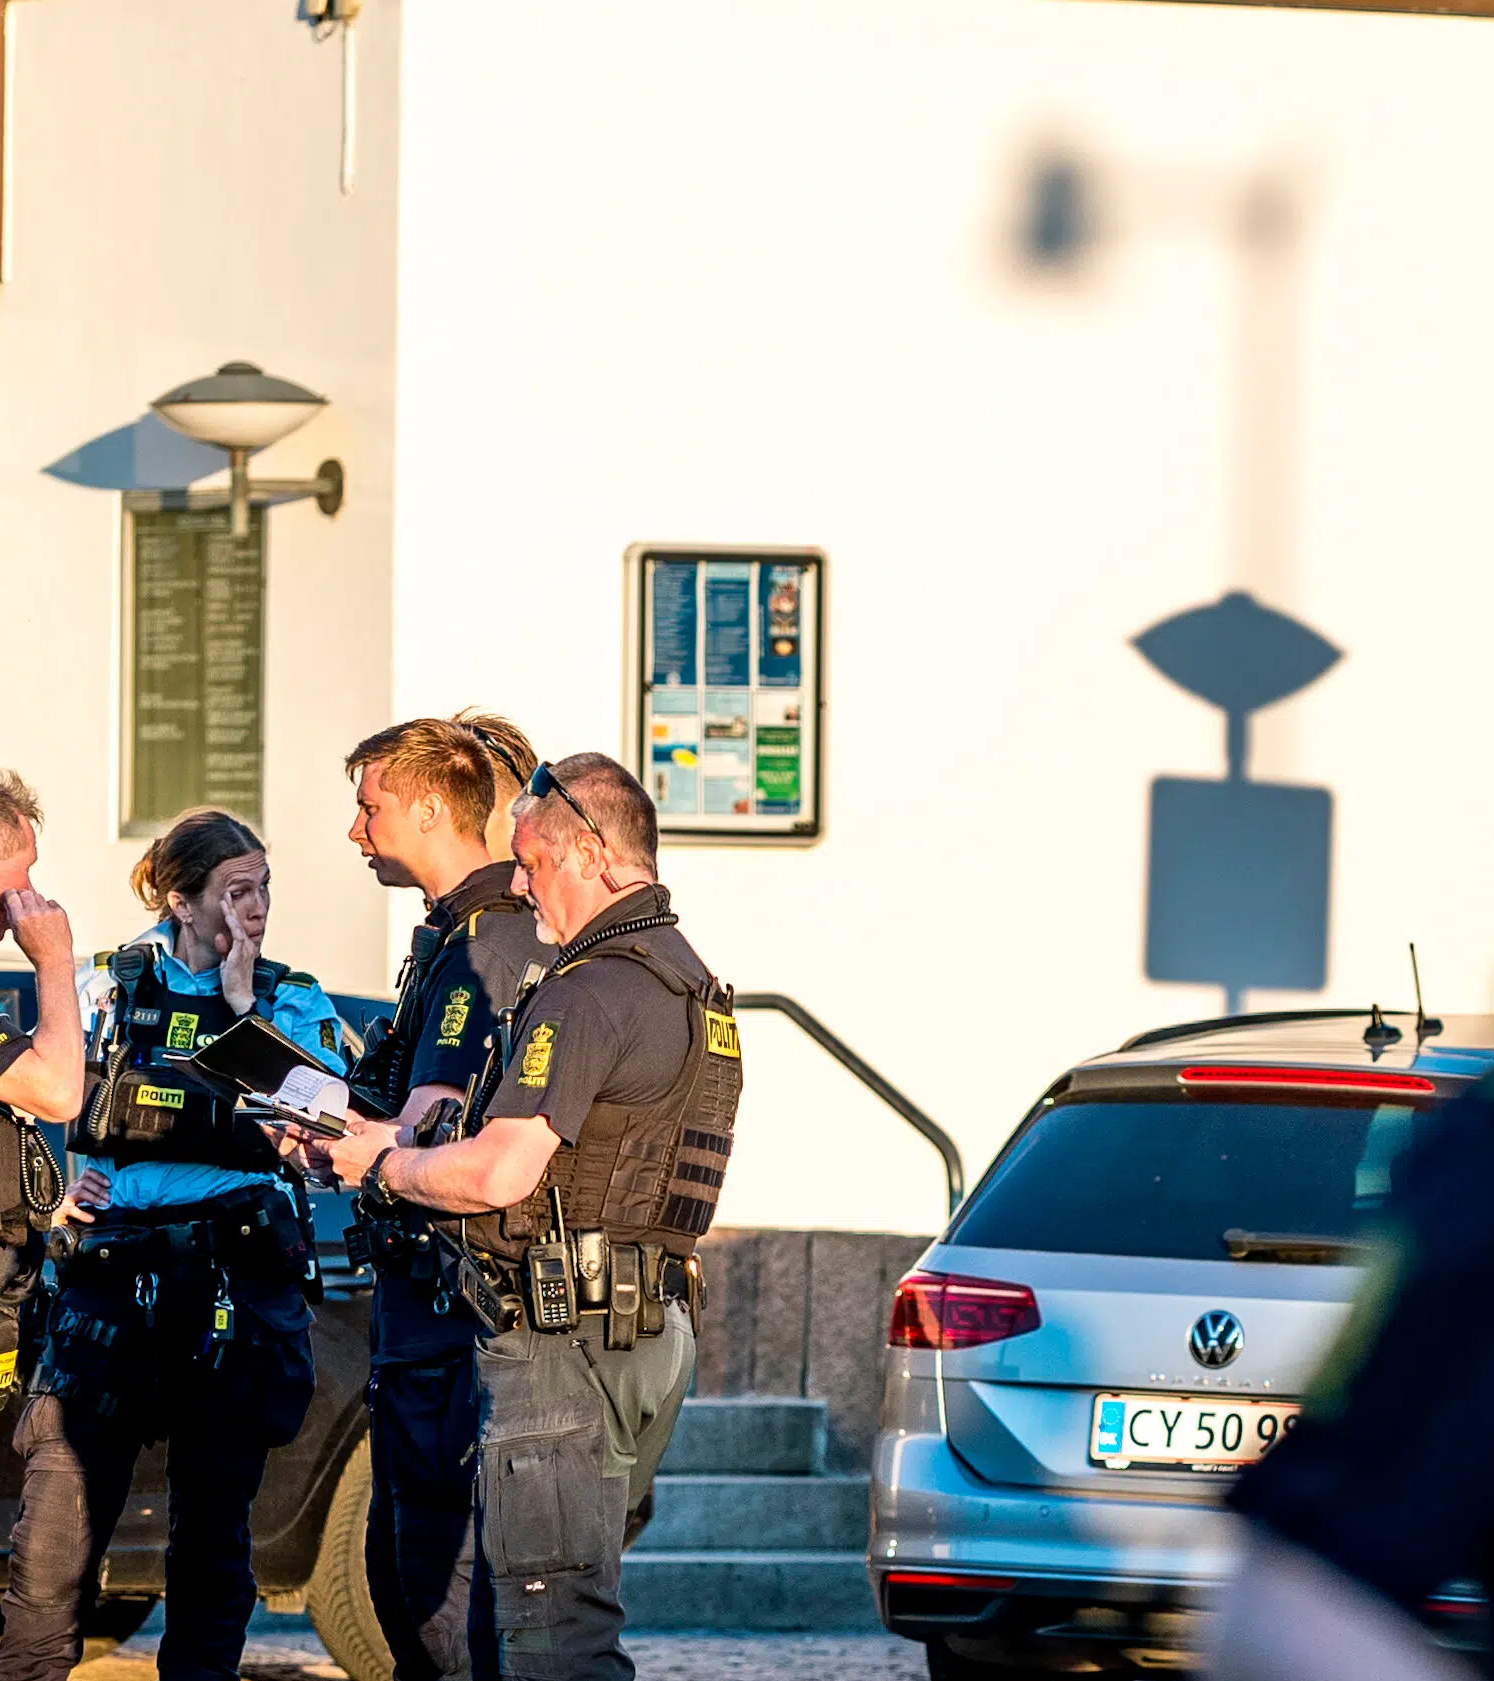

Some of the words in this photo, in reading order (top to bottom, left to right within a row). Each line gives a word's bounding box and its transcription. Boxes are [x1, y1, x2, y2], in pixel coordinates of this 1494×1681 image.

[437, 1038, 460, 1047] POLITI
[518, 1076, 546, 1088] POLITI
[140, 1089, 182, 1104] POLITI
[1129, 1409, 1182, 1448] CY
[1195, 1412, 1243, 1452] 50
